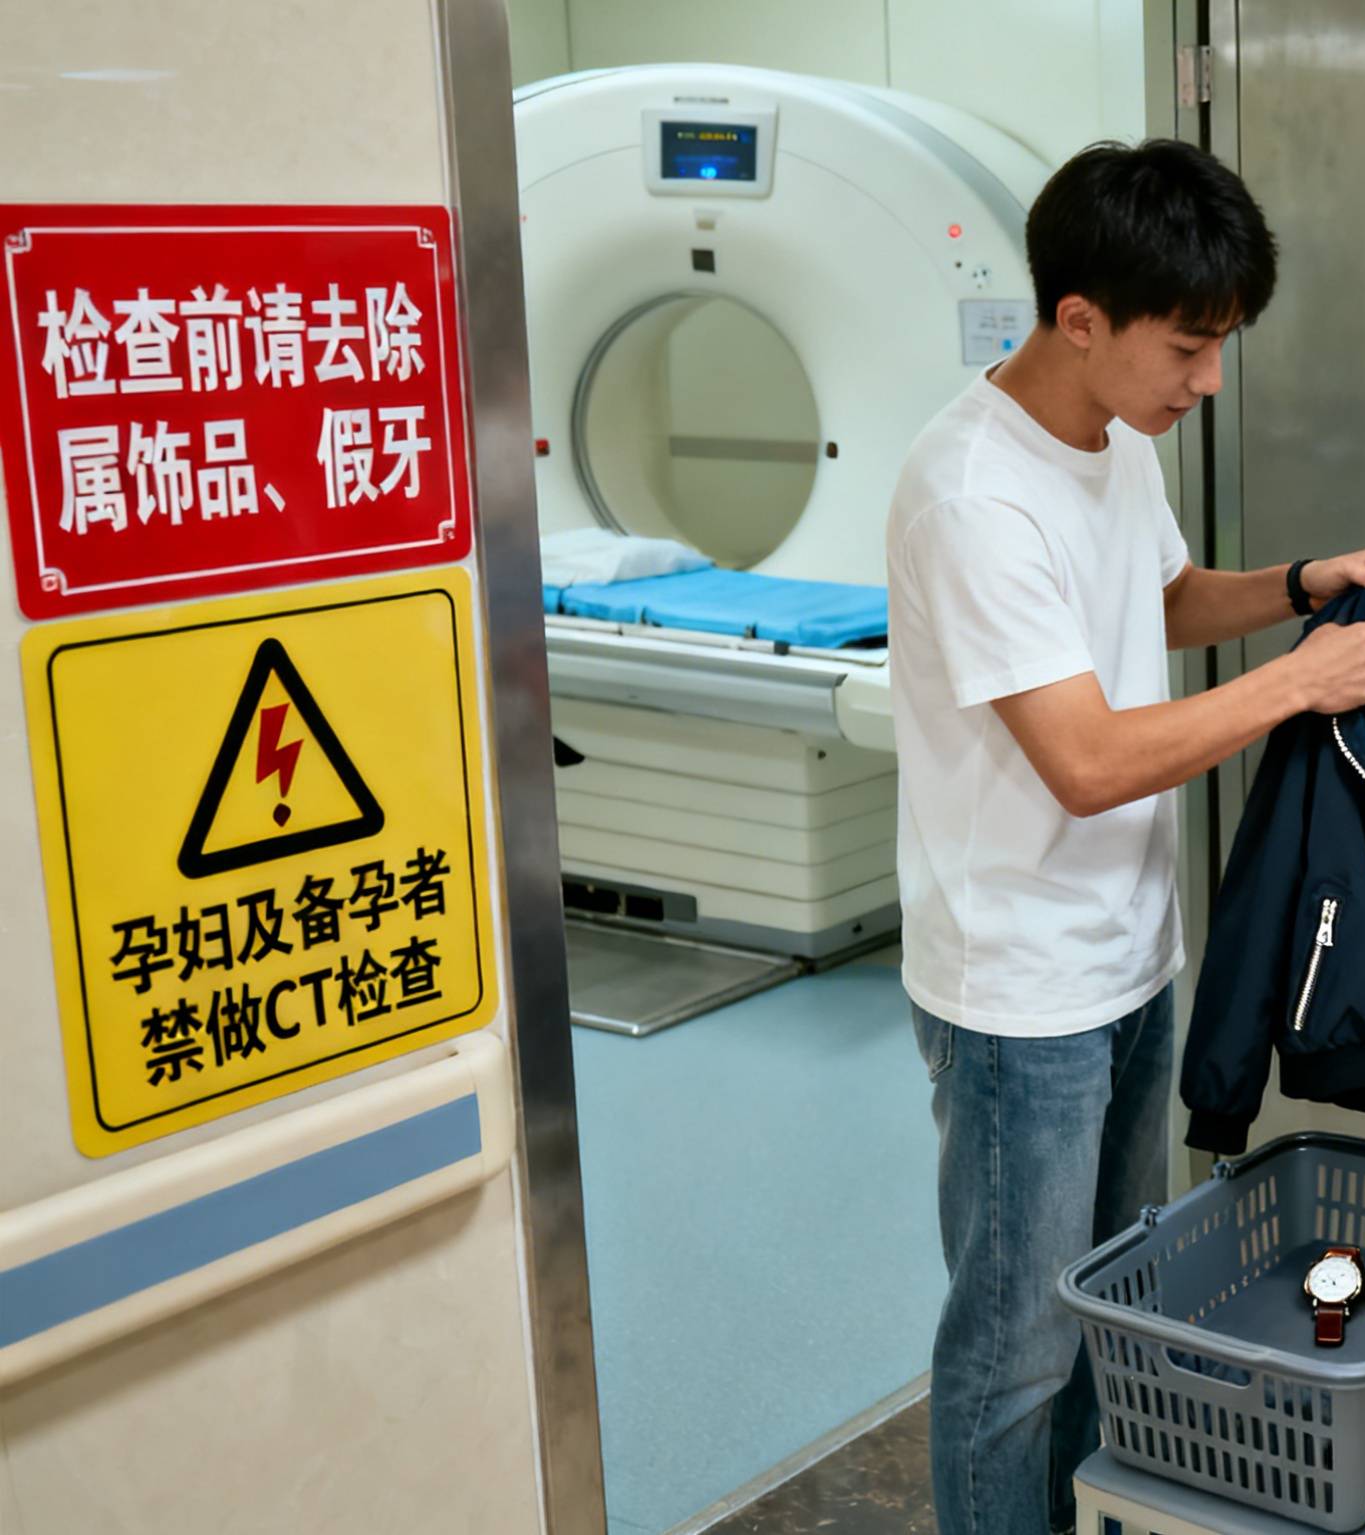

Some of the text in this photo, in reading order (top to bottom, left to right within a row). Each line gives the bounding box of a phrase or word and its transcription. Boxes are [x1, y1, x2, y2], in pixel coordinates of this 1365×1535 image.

[37, 282, 426, 399] 检查前请去除
[57, 405, 432, 536] 属饰品、假牙
[110, 846, 451, 995] 孕妇及备孕者
[140, 935, 443, 1087] 禁做CT检查
